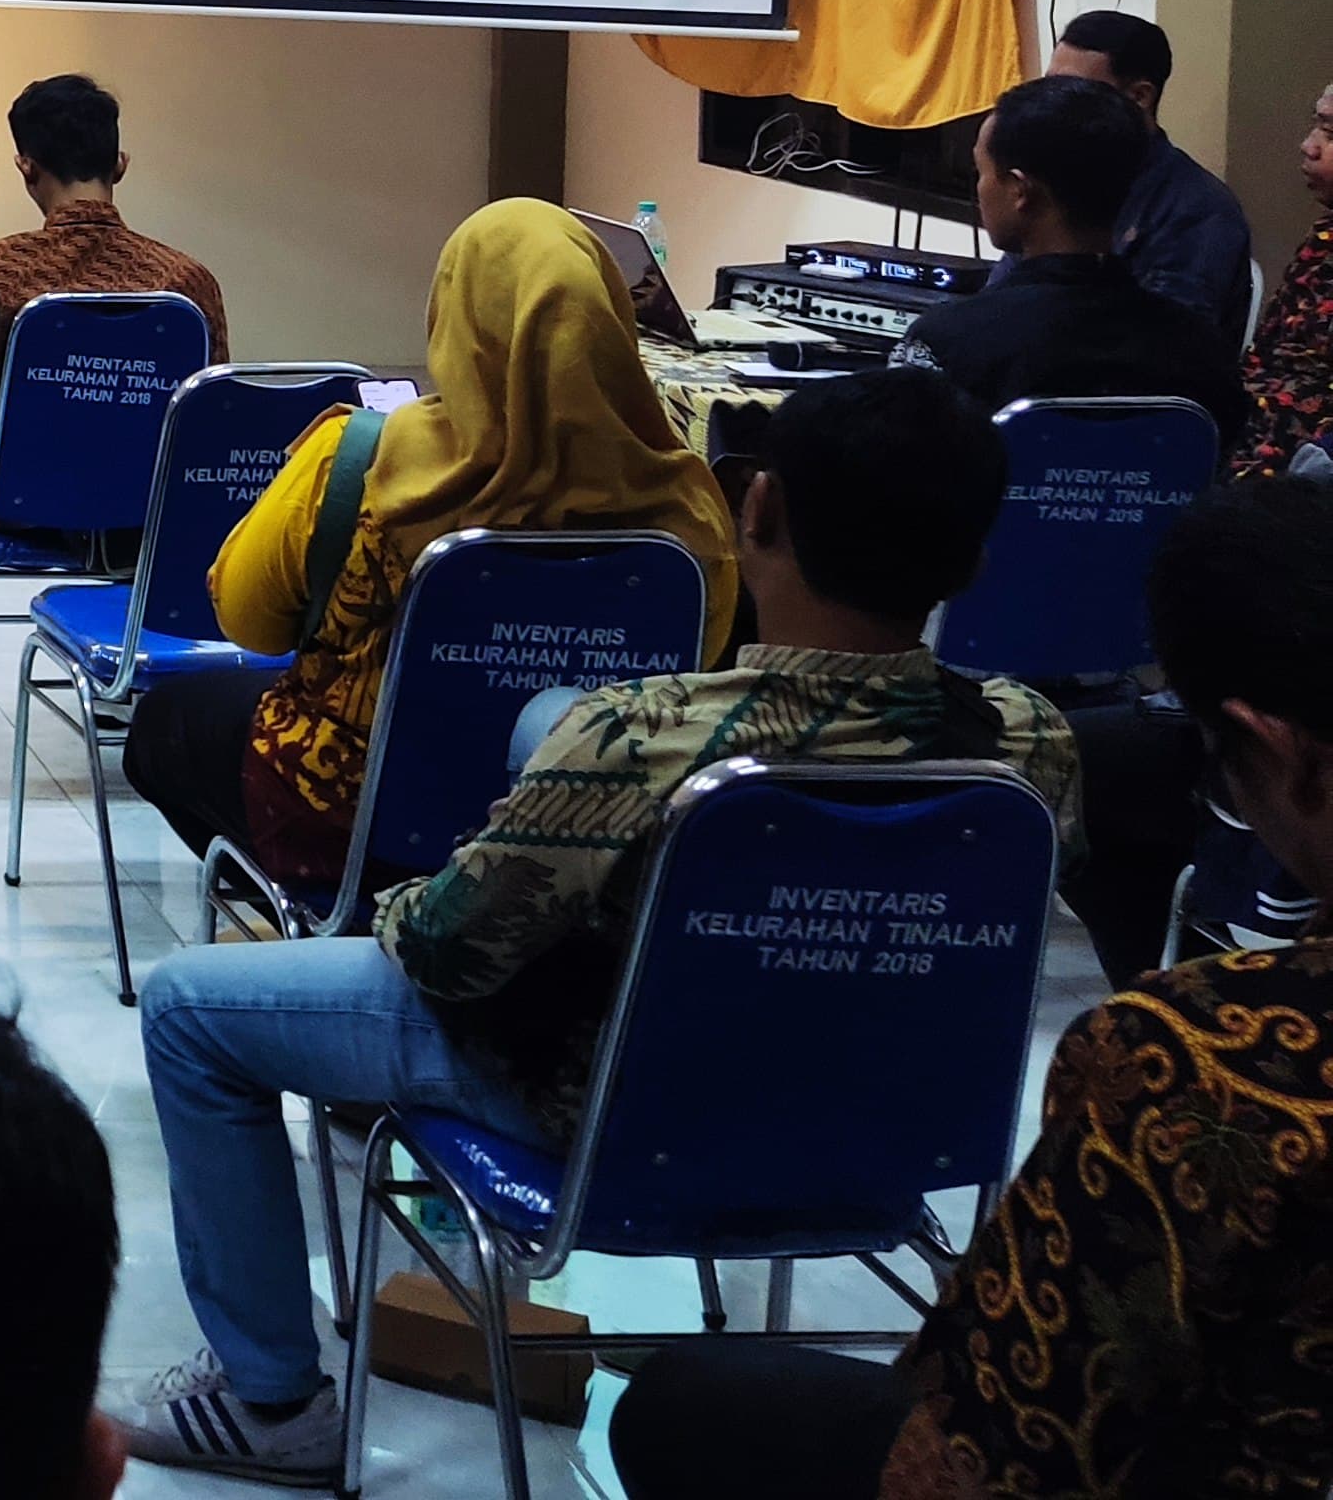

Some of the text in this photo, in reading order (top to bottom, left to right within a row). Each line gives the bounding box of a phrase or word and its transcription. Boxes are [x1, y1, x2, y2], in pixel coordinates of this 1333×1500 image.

[67, 354, 157, 373] INVENTARIS
[27, 367, 180, 391] KELURAHAN TINALA
[63, 387, 151, 405] TAHUN 2018
[184, 467, 280, 483] KELURAHA
[1044, 468, 1152, 485] INVENTARIS
[226, 486, 264, 501] TAH
[1002, 485, 1194, 506] ELURAHAN TINALAN
[1037, 505, 1144, 523] TAHUN 2018
[492, 622, 626, 646] INVENTARIS
[431, 643, 680, 672] KELURAHAN TINALAN
[486, 669, 562, 690] TAHUN
[768, 886, 947, 916] INVENTARIS
[685, 910, 1016, 948] KELURAHAN TINALAN
[758, 946, 934, 975] TAHUN 2018
